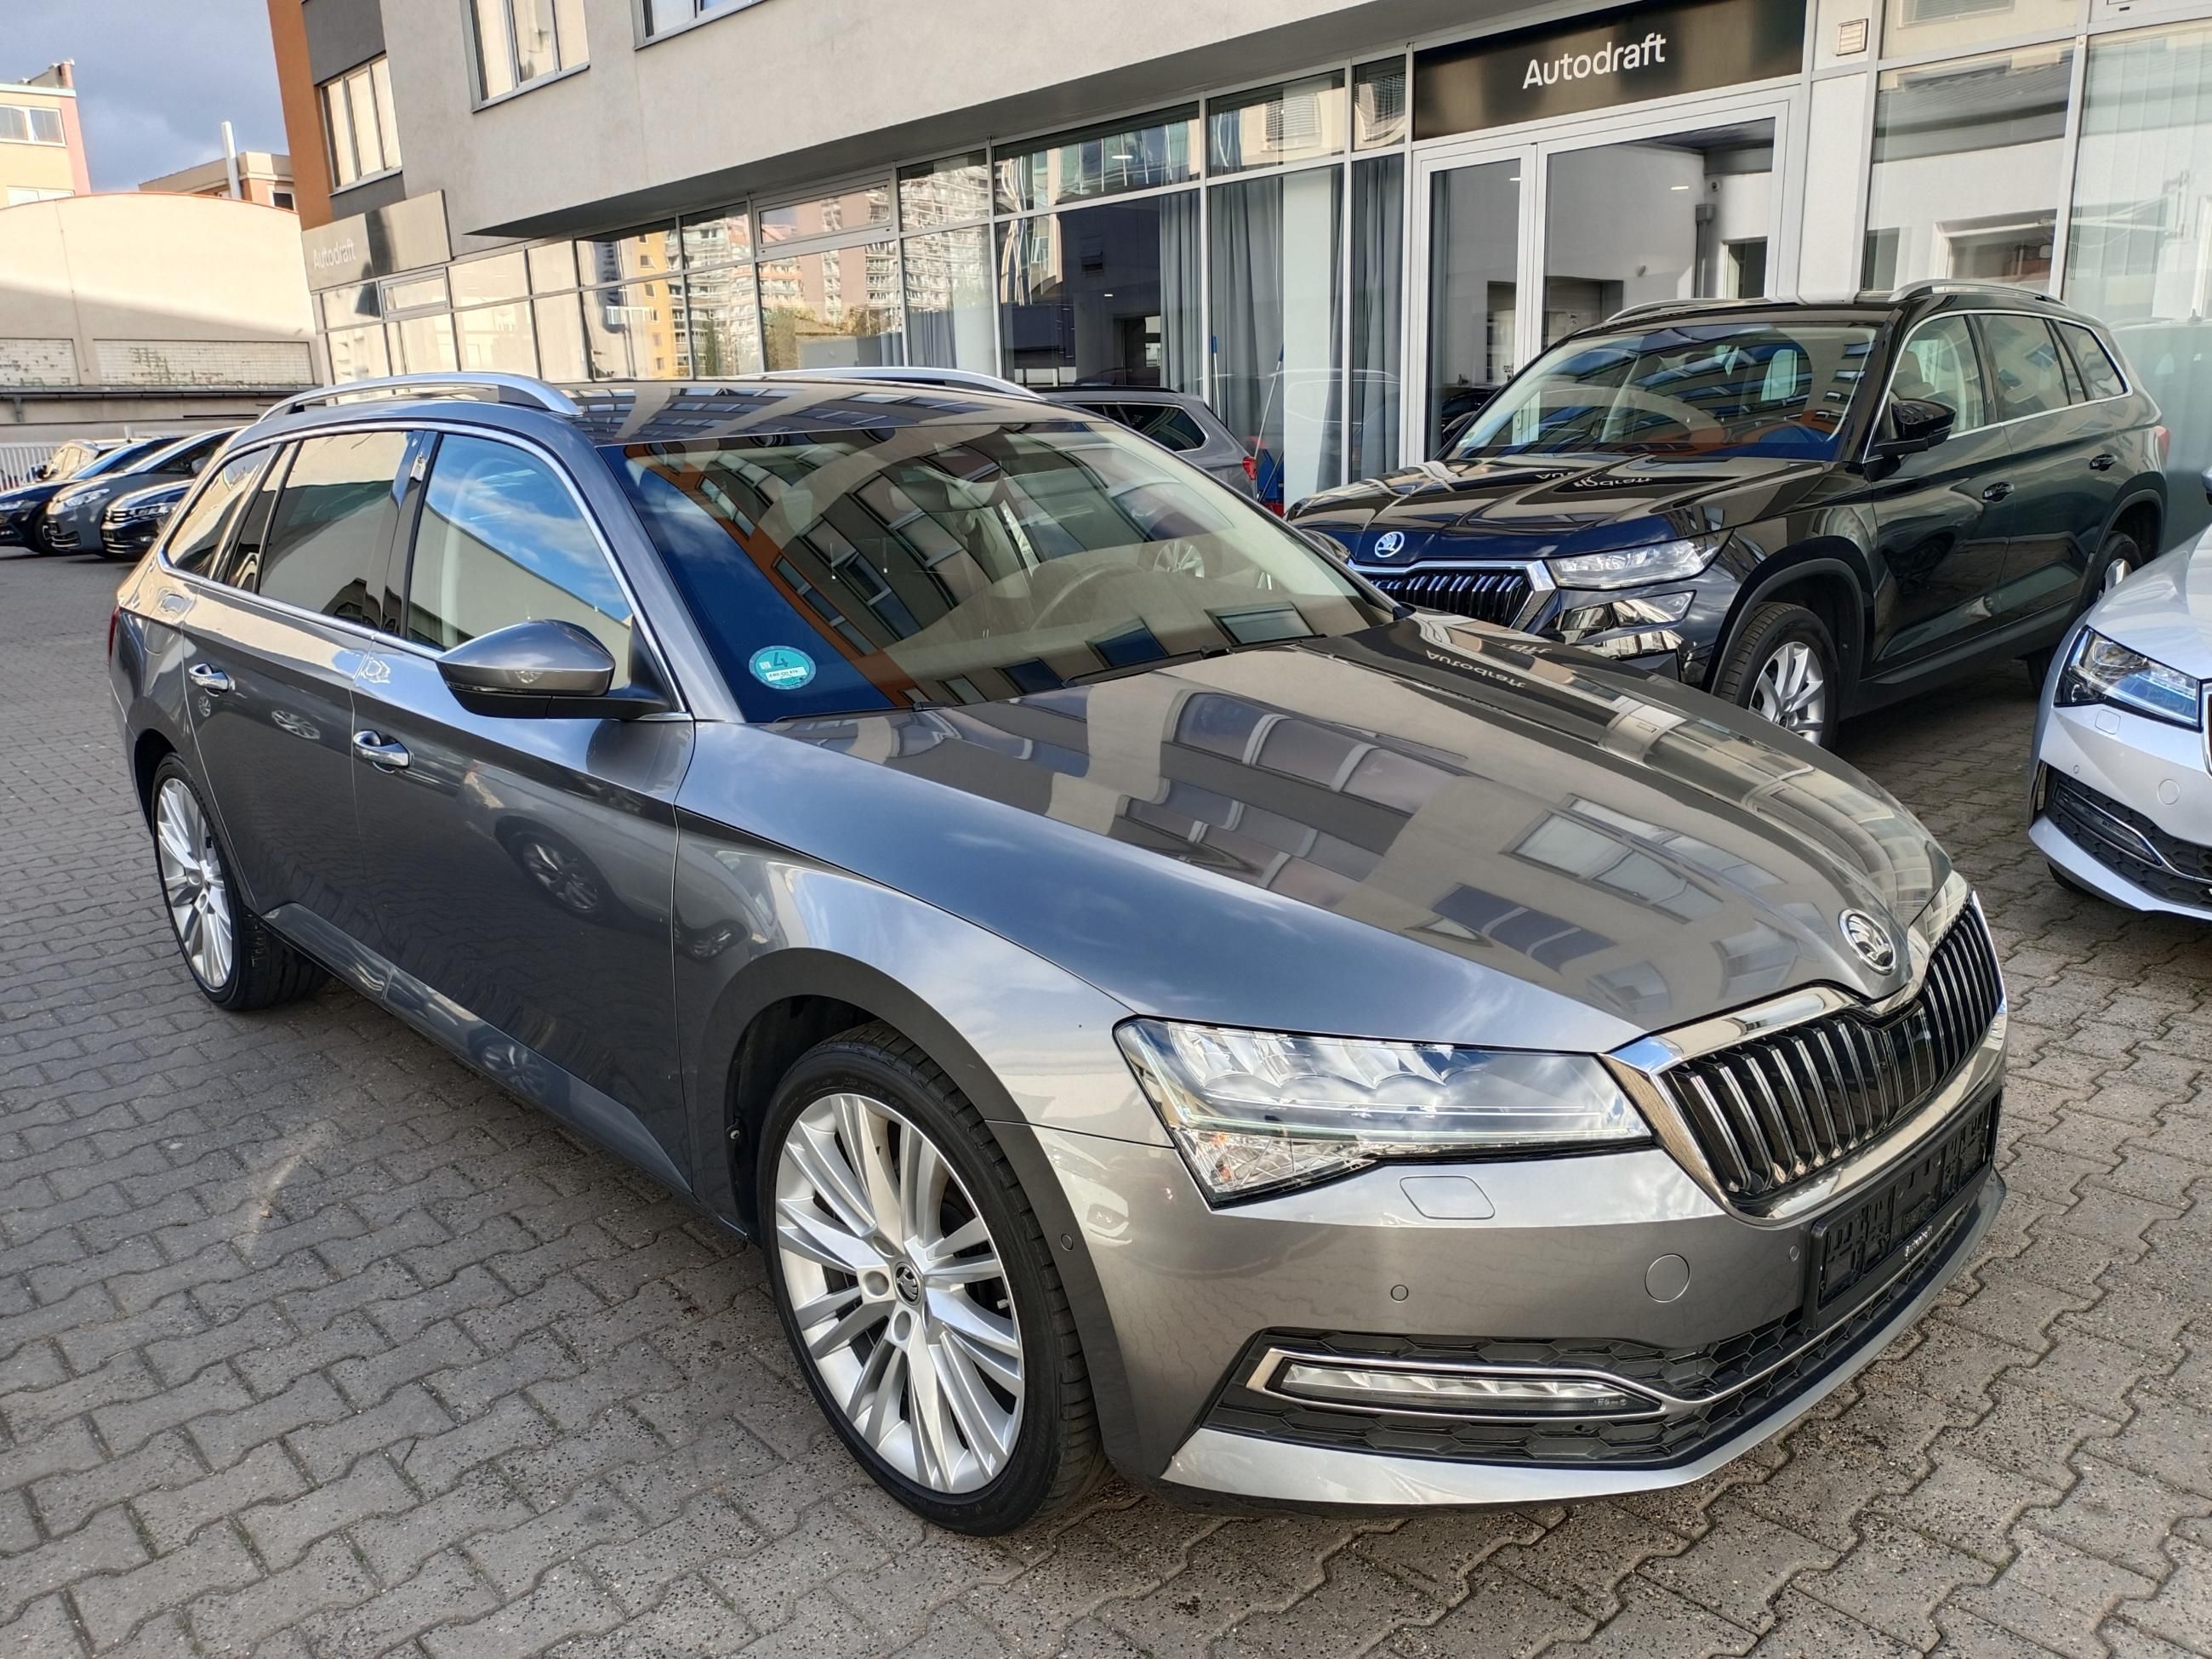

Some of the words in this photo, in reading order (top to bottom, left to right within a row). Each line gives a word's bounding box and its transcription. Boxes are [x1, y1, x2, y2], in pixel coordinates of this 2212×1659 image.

[1522, 31, 1667, 90] Autodraft
[312, 237, 356, 271] Autodraft
[772, 652, 789, 668] 4
